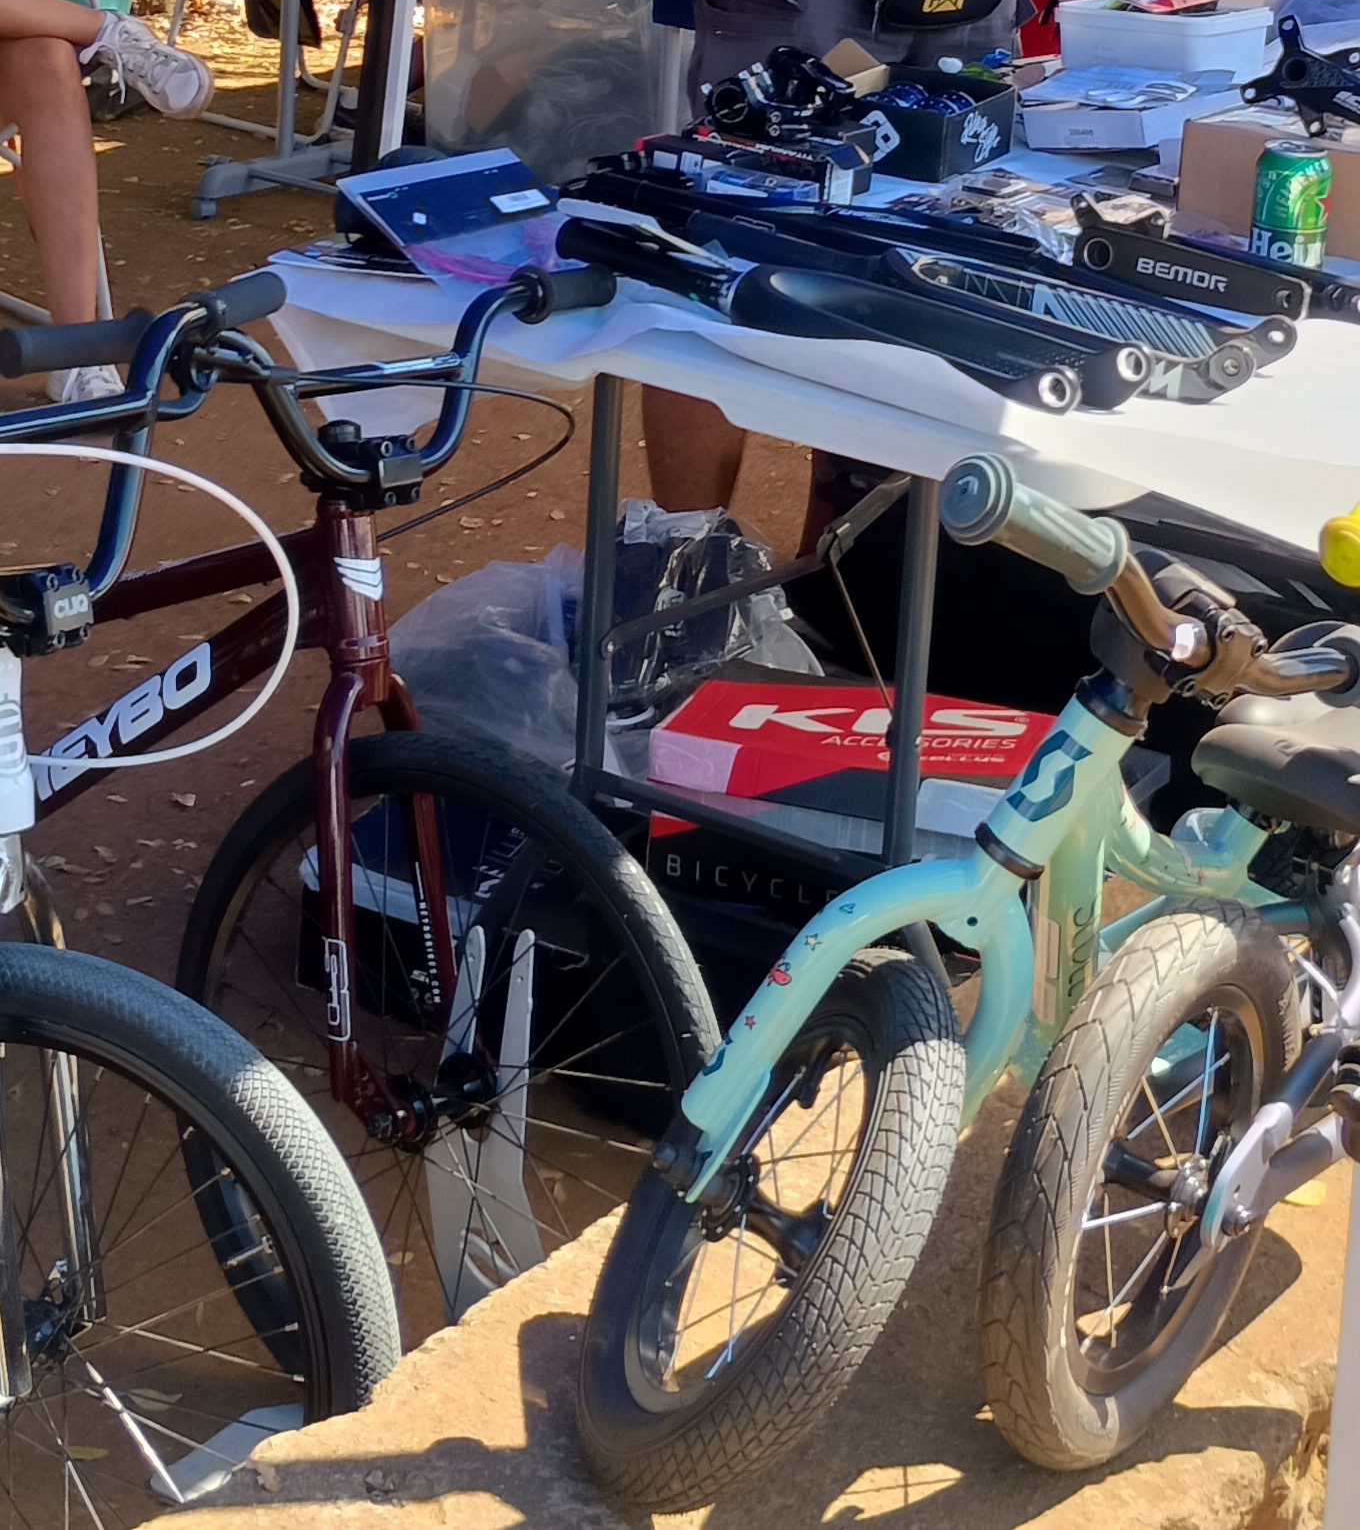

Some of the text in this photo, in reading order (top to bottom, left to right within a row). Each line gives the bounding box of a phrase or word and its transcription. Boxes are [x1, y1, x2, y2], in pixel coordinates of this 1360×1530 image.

[1136, 255, 1229, 293] BEMOR
[53, 594, 92, 620] CLIQ
[820, 735, 1018, 749] ACCESORIES
